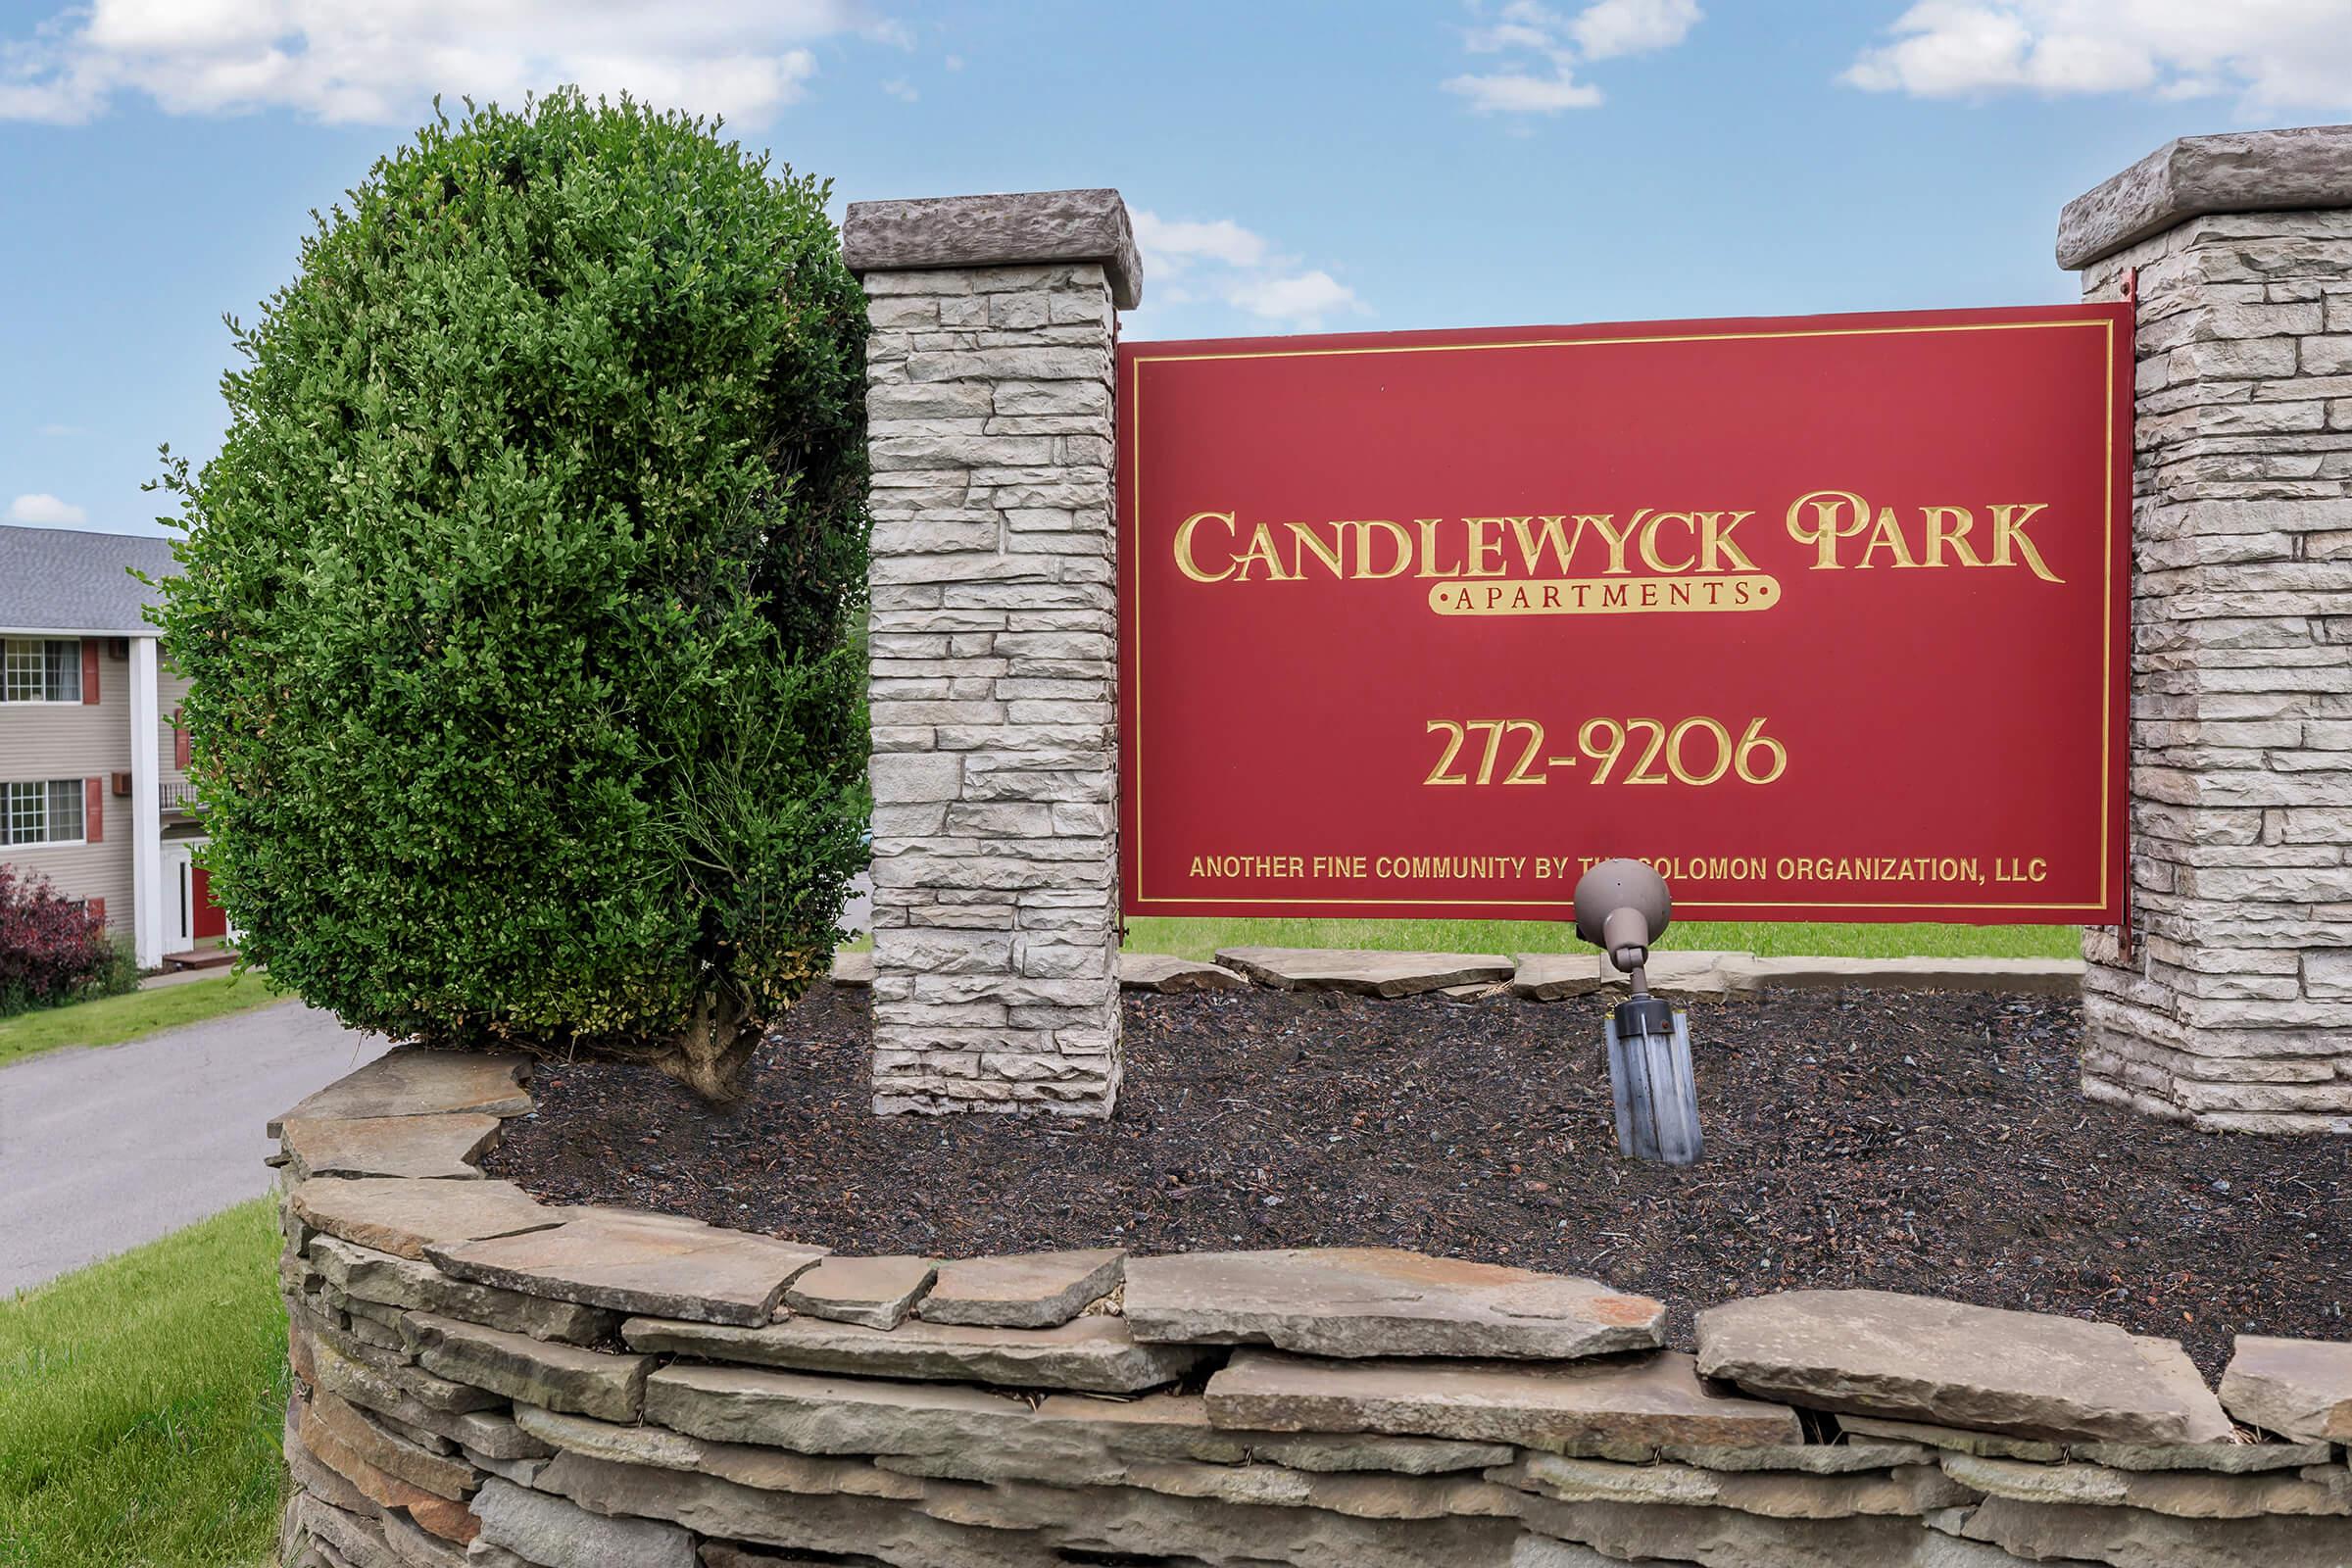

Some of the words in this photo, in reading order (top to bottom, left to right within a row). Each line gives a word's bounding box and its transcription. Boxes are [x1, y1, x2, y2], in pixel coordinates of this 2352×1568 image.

[1173, 508, 1762, 583] CANDLEWYCK
[1786, 489, 2066, 584] PARK
[1454, 581, 1750, 611] APARTMENTS
[1423, 716, 1788, 786] 272-9206
[1189, 855, 1304, 878] ANOTHER
[1313, 856, 1367, 878] FINE
[1375, 856, 1527, 879] COMMUNITY
[1535, 857, 1569, 879] BY
[1639, 857, 1767, 881] OLOMON
[1776, 857, 1985, 886] ORGANIZATION,
[1995, 858, 2047, 882] LLC
